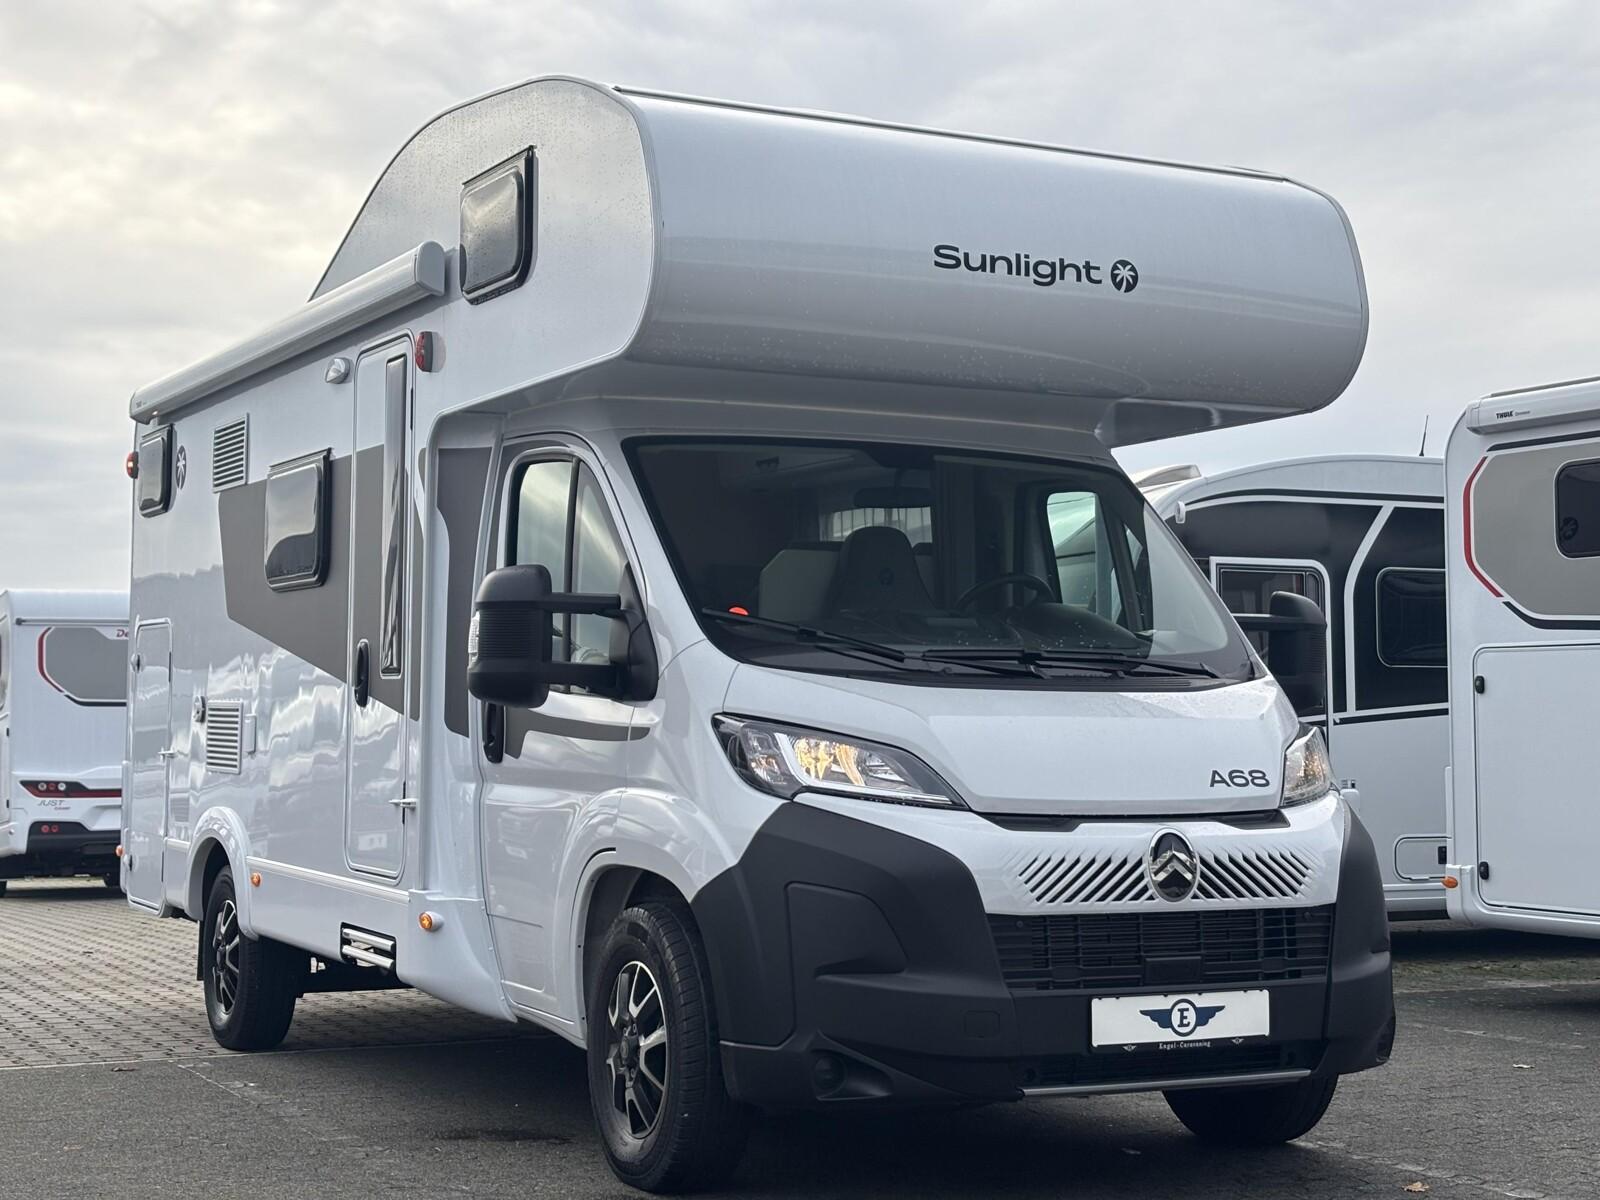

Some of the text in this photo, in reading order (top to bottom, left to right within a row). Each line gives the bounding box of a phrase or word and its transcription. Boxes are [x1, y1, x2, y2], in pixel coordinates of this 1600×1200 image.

[933, 244, 1103, 287] Sunlight
[1496, 410, 1514, 419] THULE
[1209, 769, 1270, 788] A68
[37, 799, 65, 807] JUST
[1177, 1007, 1191, 1028] E
